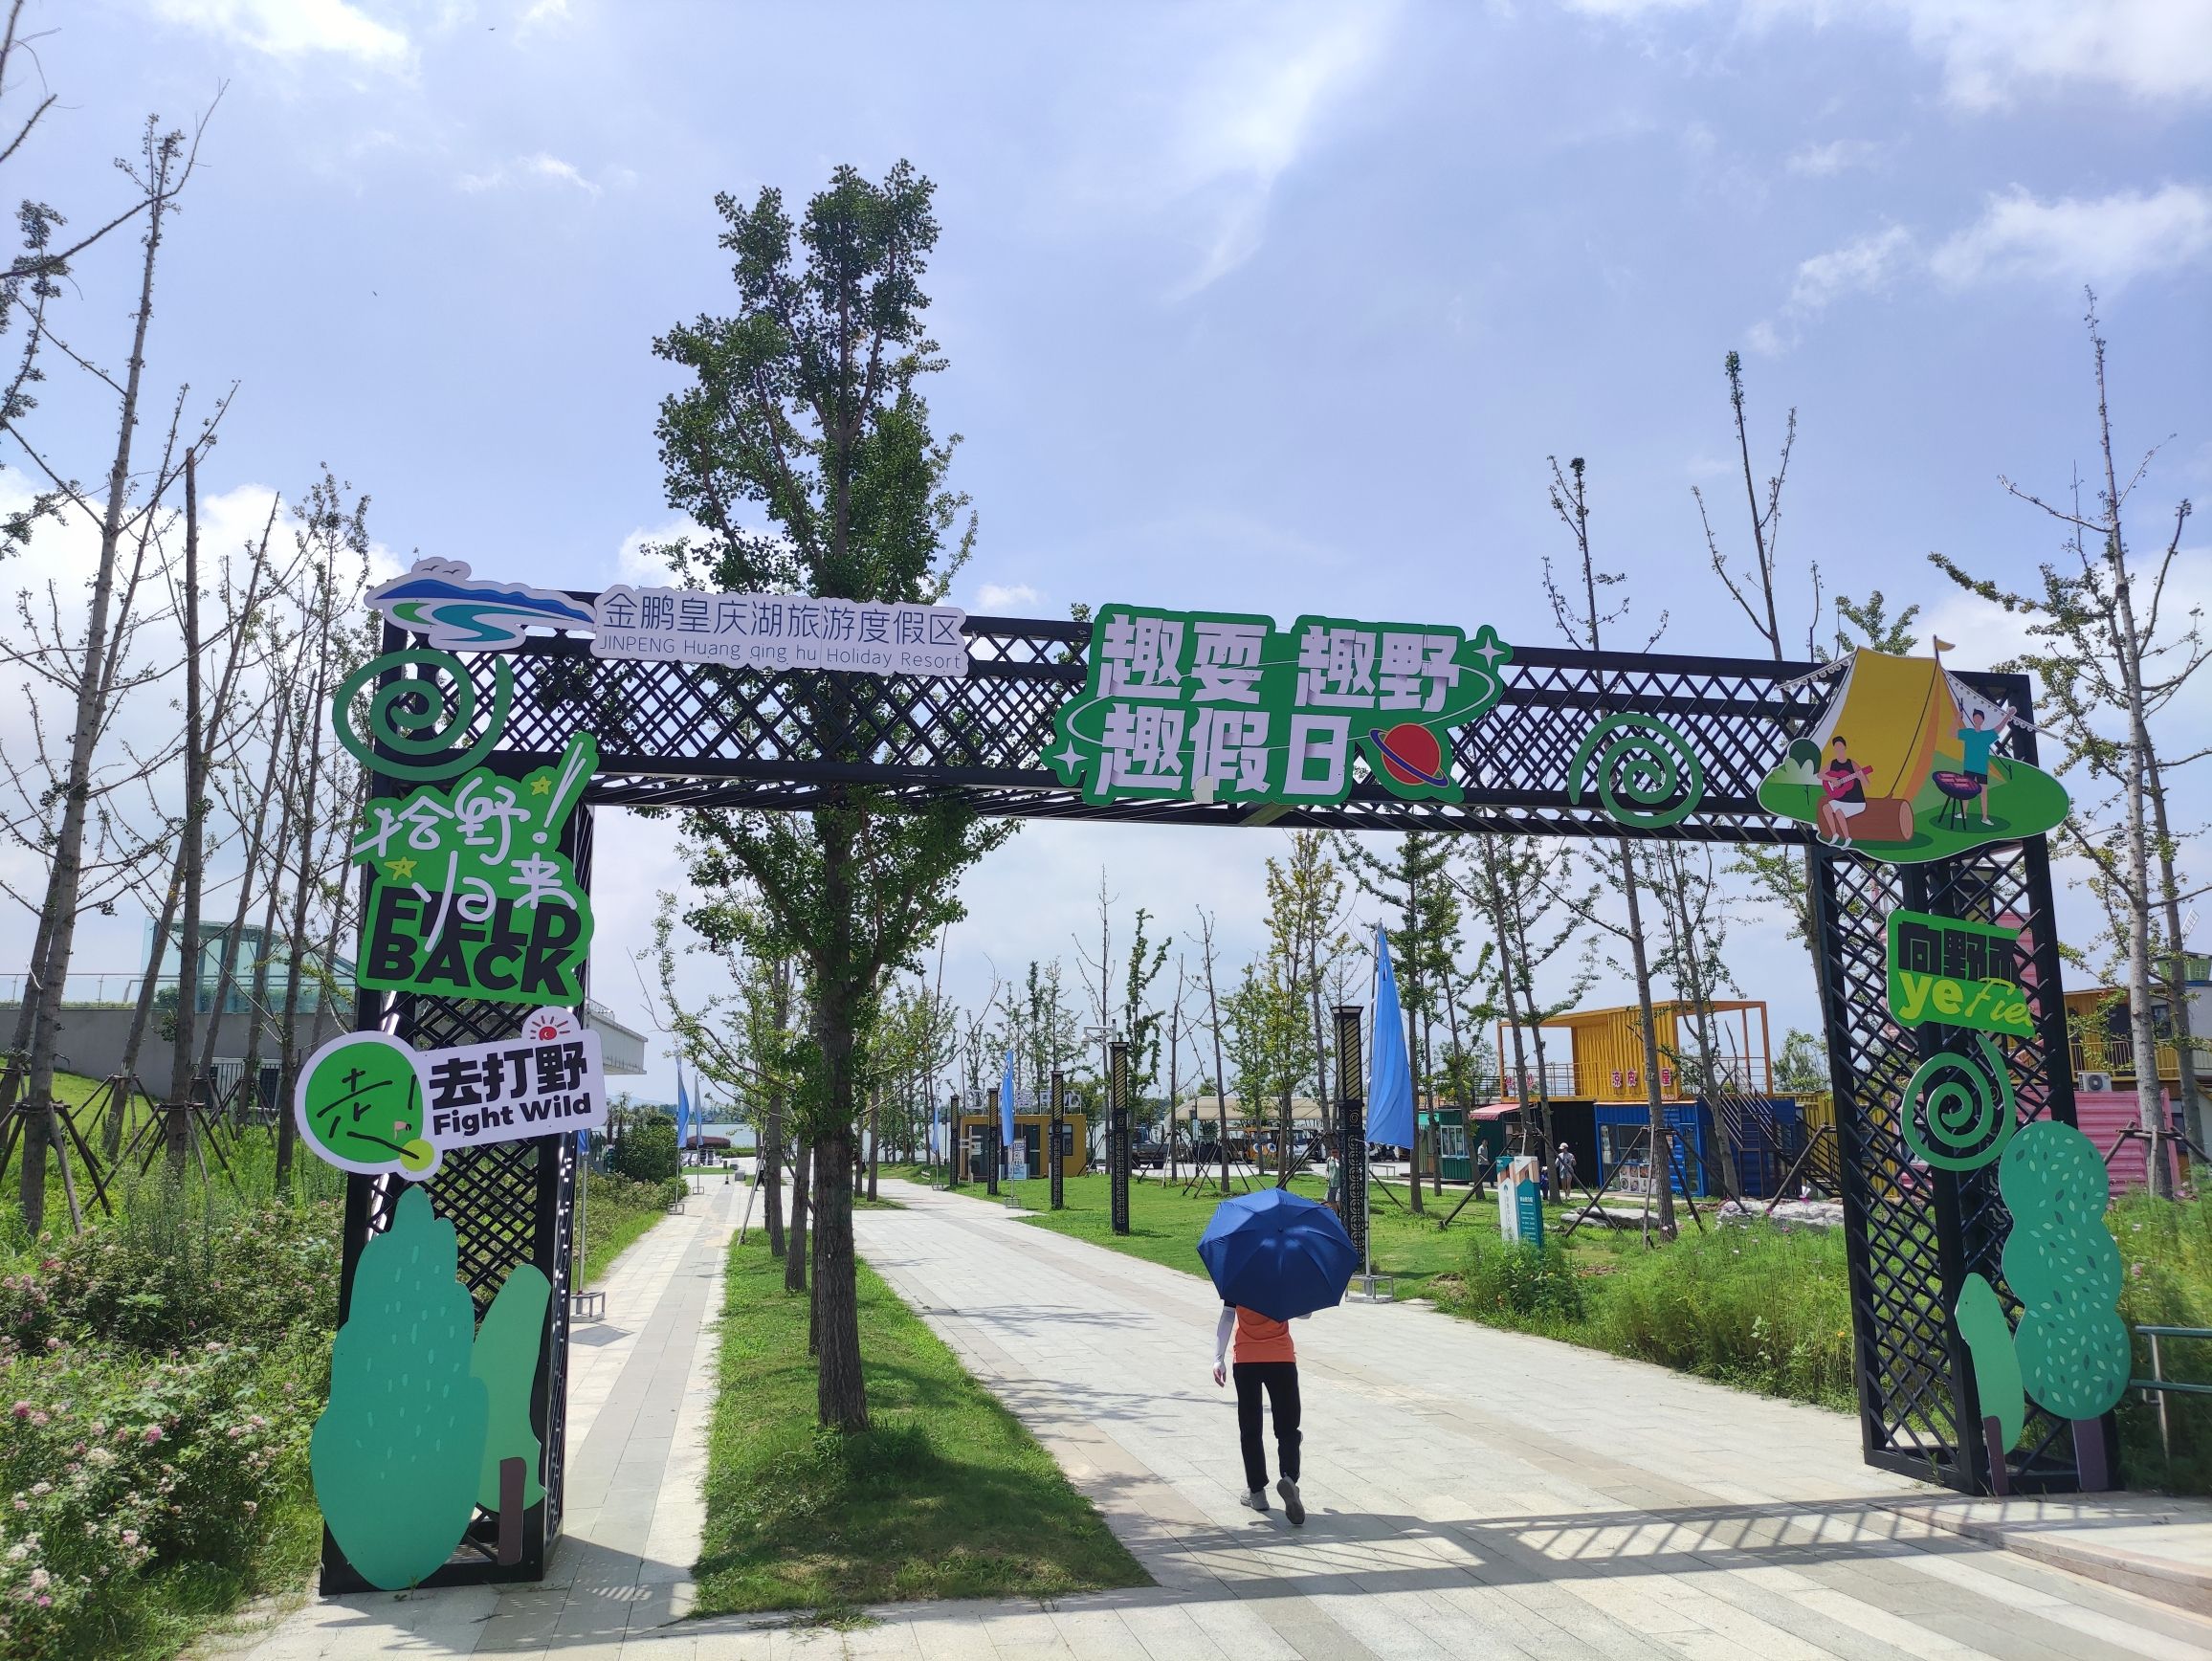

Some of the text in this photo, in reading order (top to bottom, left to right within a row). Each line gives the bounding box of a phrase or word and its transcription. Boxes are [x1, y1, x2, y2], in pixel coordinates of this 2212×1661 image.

[603, 591, 959, 647] 金鹏皇庆湖旅游度假区
[599, 635, 960, 671] JINPENG Huang qing hu Holiday Resort
[1096, 612, 1461, 713] 趣耍 趣野
[1094, 701, 1352, 796] 趣假日
[366, 932, 574, 997] BACK
[429, 1040, 588, 1111] 去打野
[433, 1093, 592, 1137] Fight Wild
